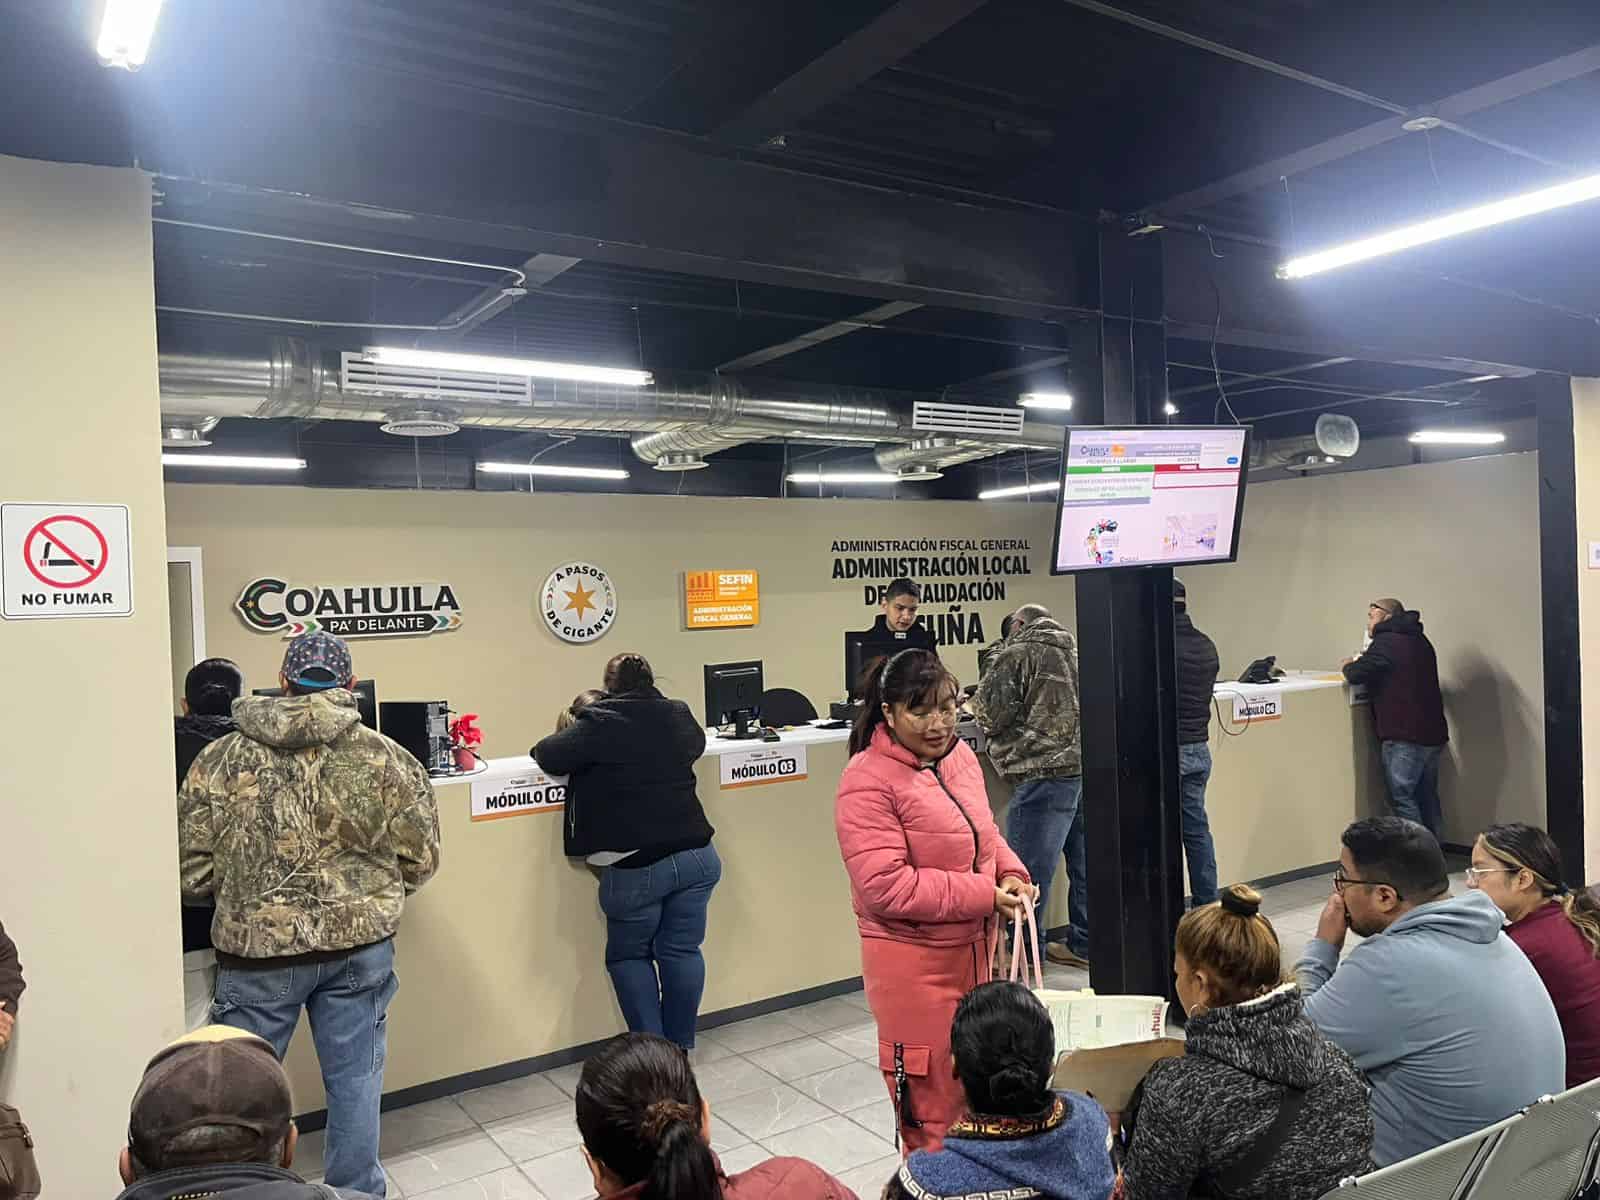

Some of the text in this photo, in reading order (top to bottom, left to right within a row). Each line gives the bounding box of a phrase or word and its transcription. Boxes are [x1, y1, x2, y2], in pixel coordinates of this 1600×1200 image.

[831, 537, 1031, 552] ADMINISTRACIÓN FISCAL GENERAL
[556, 566, 605, 582] A PASOS
[832, 552, 1031, 579] ADMINISTRACIÓN LOCAL
[719, 574, 753, 584] SEFIN
[22, 592, 114, 605] NO FUMAR
[239, 578, 459, 628] COAHUILA
[357, 617, 425, 631] DELANTE
[547, 608, 614, 638] DE GIGANTE
[731, 760, 795, 779] MÓDULO 03
[485, 786, 567, 809] MÓDULO 02
